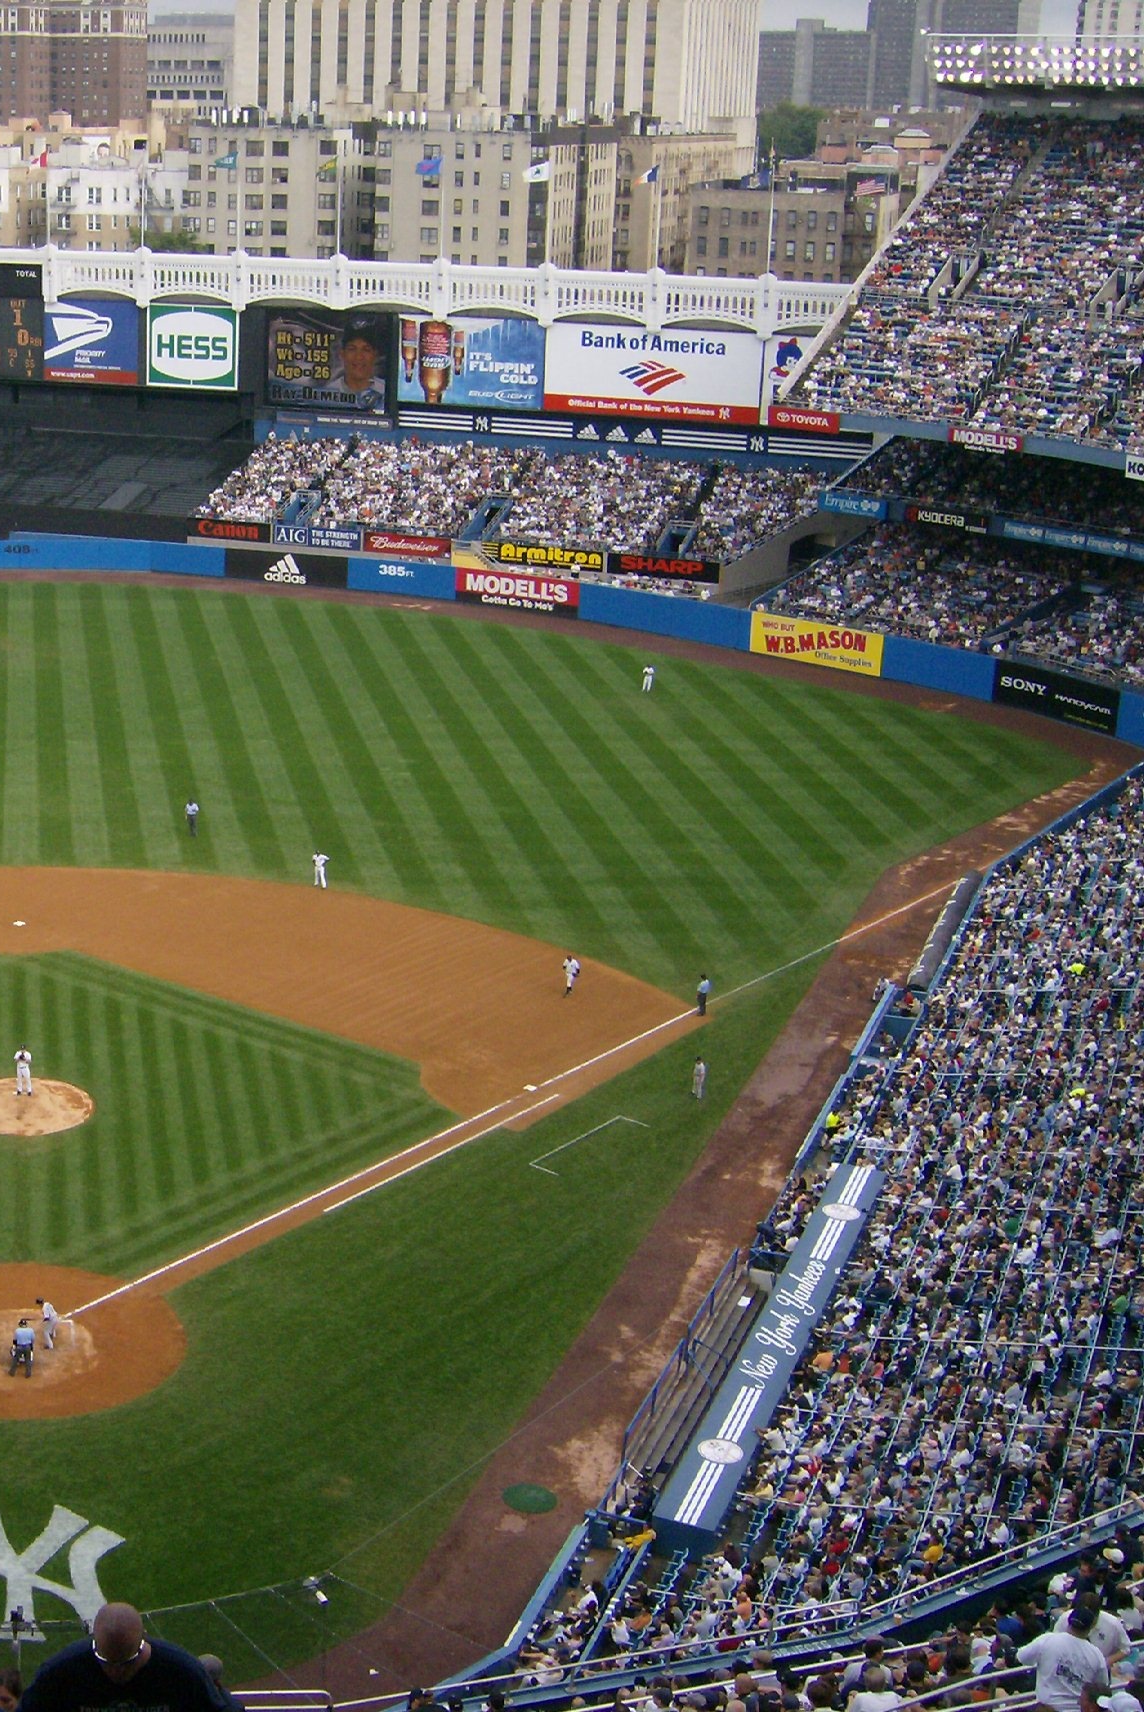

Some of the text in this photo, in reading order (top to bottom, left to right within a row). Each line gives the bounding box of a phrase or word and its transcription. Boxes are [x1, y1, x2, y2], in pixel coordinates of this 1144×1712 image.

[15, 270, 37, 278] TOTAL
[13, 309, 23, 326] 1
[17, 328, 29, 346] 0
[277, 331, 291, 344] Ht
[581, 331, 726, 356] Bank of America
[157, 334, 227, 361] HESS
[277, 348, 292, 361] Wt
[306, 349, 328, 362] 155
[469, 351, 493, 361] IT'S
[276, 364, 330, 380] Age 26
[469, 360, 535, 374] FLIPPIN'
[499, 374, 539, 385] COLD
[568, 399, 596, 408] Official
[598, 401, 618, 410] Bank
[644, 404, 662, 412] New
[663, 405, 681, 414] York
[683, 407, 715, 416] Yankees
[791, 414, 829, 427] TOYOTA
[953, 430, 1018, 450] MODELL'S
[825, 494, 859, 510] Empire
[198, 521, 259, 540] Canon
[277, 528, 305, 543] AIG
[311, 529, 358, 540] THE STRENGTH
[312, 537, 321, 546] TO
[322, 538, 332, 547] BE
[370, 534, 440, 553] Budweiser
[500, 543, 602, 566] Armitron
[379, 564, 405, 577] 385
[620, 556, 704, 575] SHARP
[264, 571, 307, 585] adidas
[466, 573, 568, 602] MODELL'S
[481, 595, 507, 605] Gotta
[508, 598, 522, 607] Go
[523, 600, 533, 609] To
[762, 621, 779, 630] WHO
[815, 650, 873, 669] Office Supplies
[1000, 675, 1048, 696] SONY
[739, 1259, 827, 1391] New York Yankees
